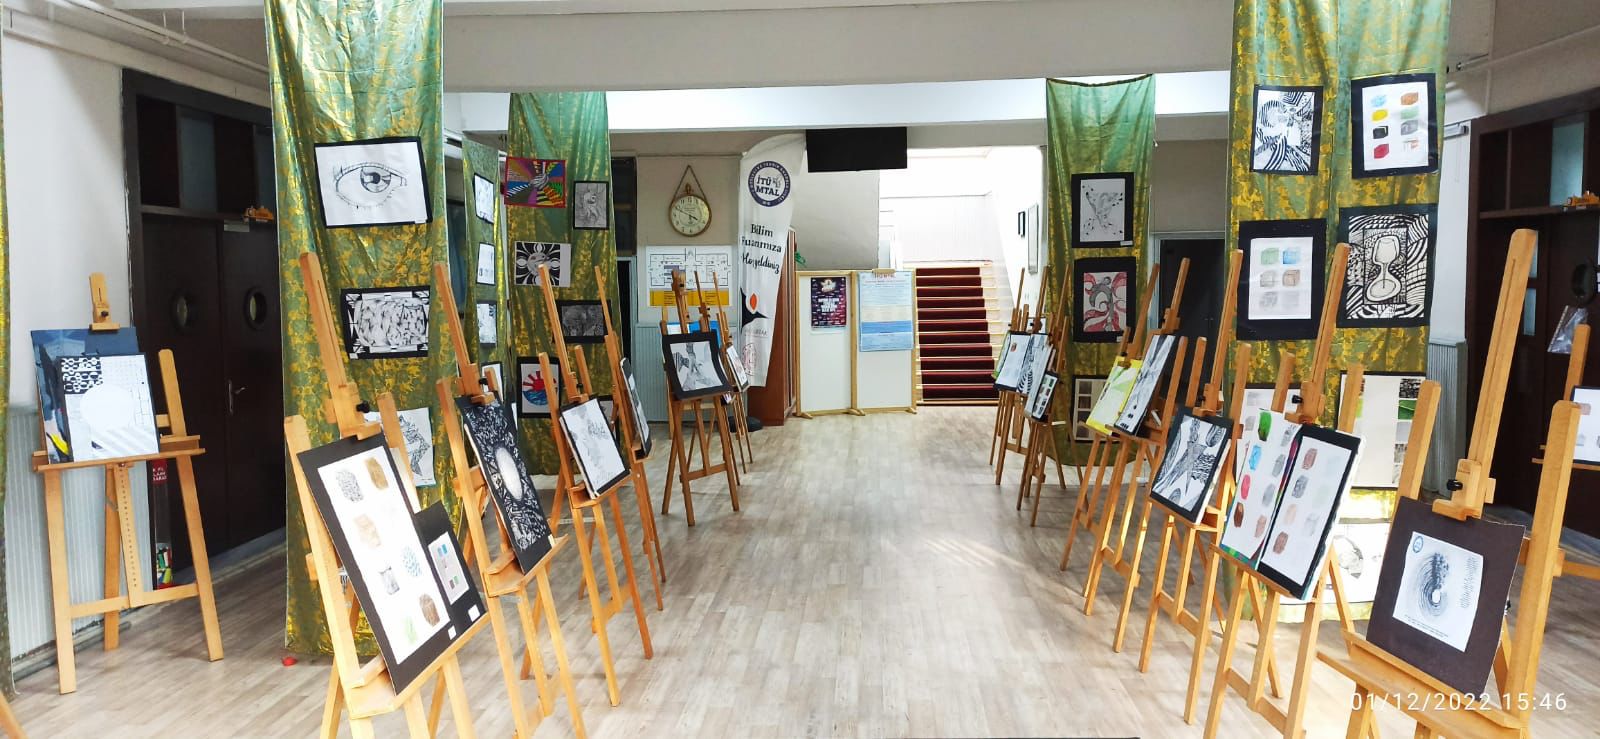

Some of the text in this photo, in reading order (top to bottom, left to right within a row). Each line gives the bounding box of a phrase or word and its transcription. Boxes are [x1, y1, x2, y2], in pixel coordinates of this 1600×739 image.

[756, 175, 772, 186] İTÜ
[756, 186, 780, 197] MTAL
[751, 223, 773, 238] Bilim
